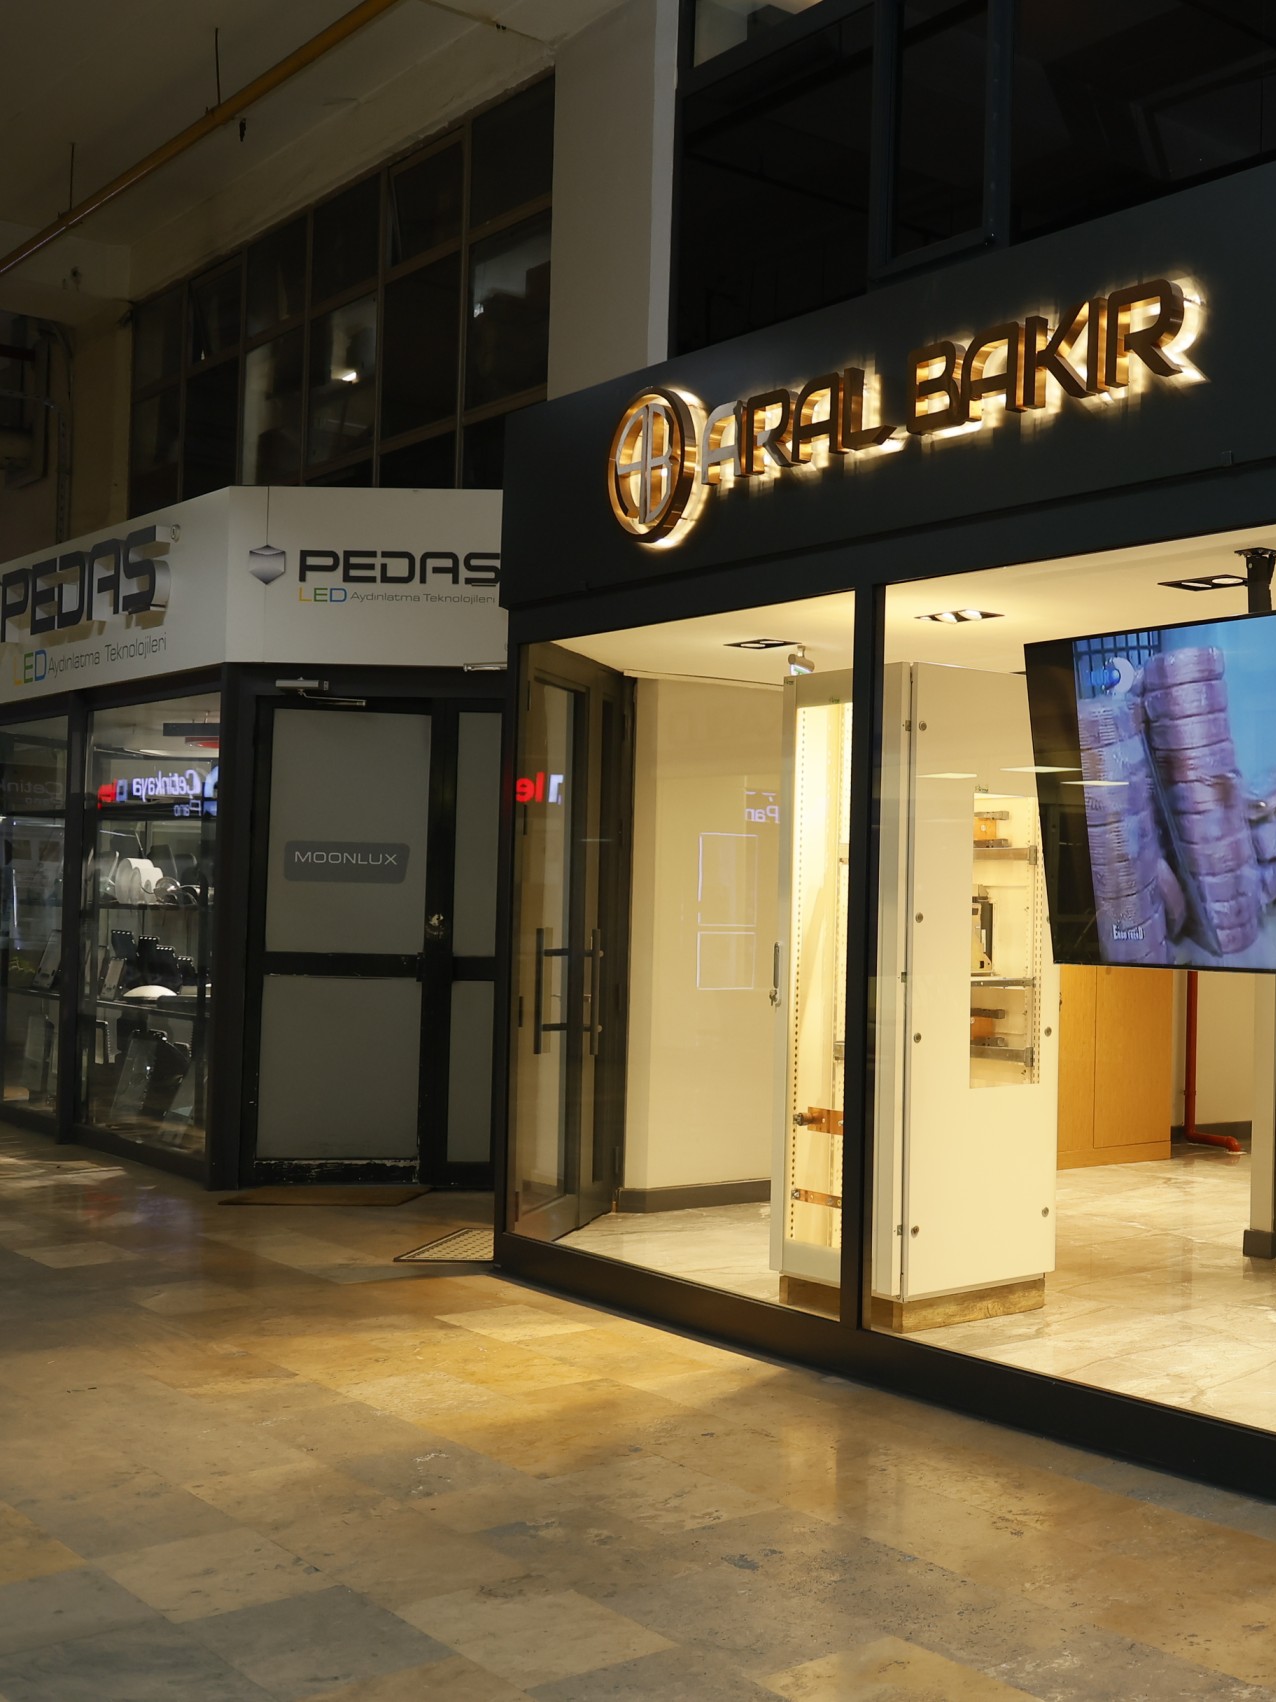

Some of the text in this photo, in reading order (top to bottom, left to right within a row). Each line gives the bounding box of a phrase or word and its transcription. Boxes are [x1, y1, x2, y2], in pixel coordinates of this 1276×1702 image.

[701, 278, 1184, 486] ARAL BAKIR
[299, 587, 496, 605] LED Aydınlatma Teknolojileri
[12, 632, 167, 686] LED Aydınlatma Teknolojileri
[294, 850, 399, 866] MOONLUX
